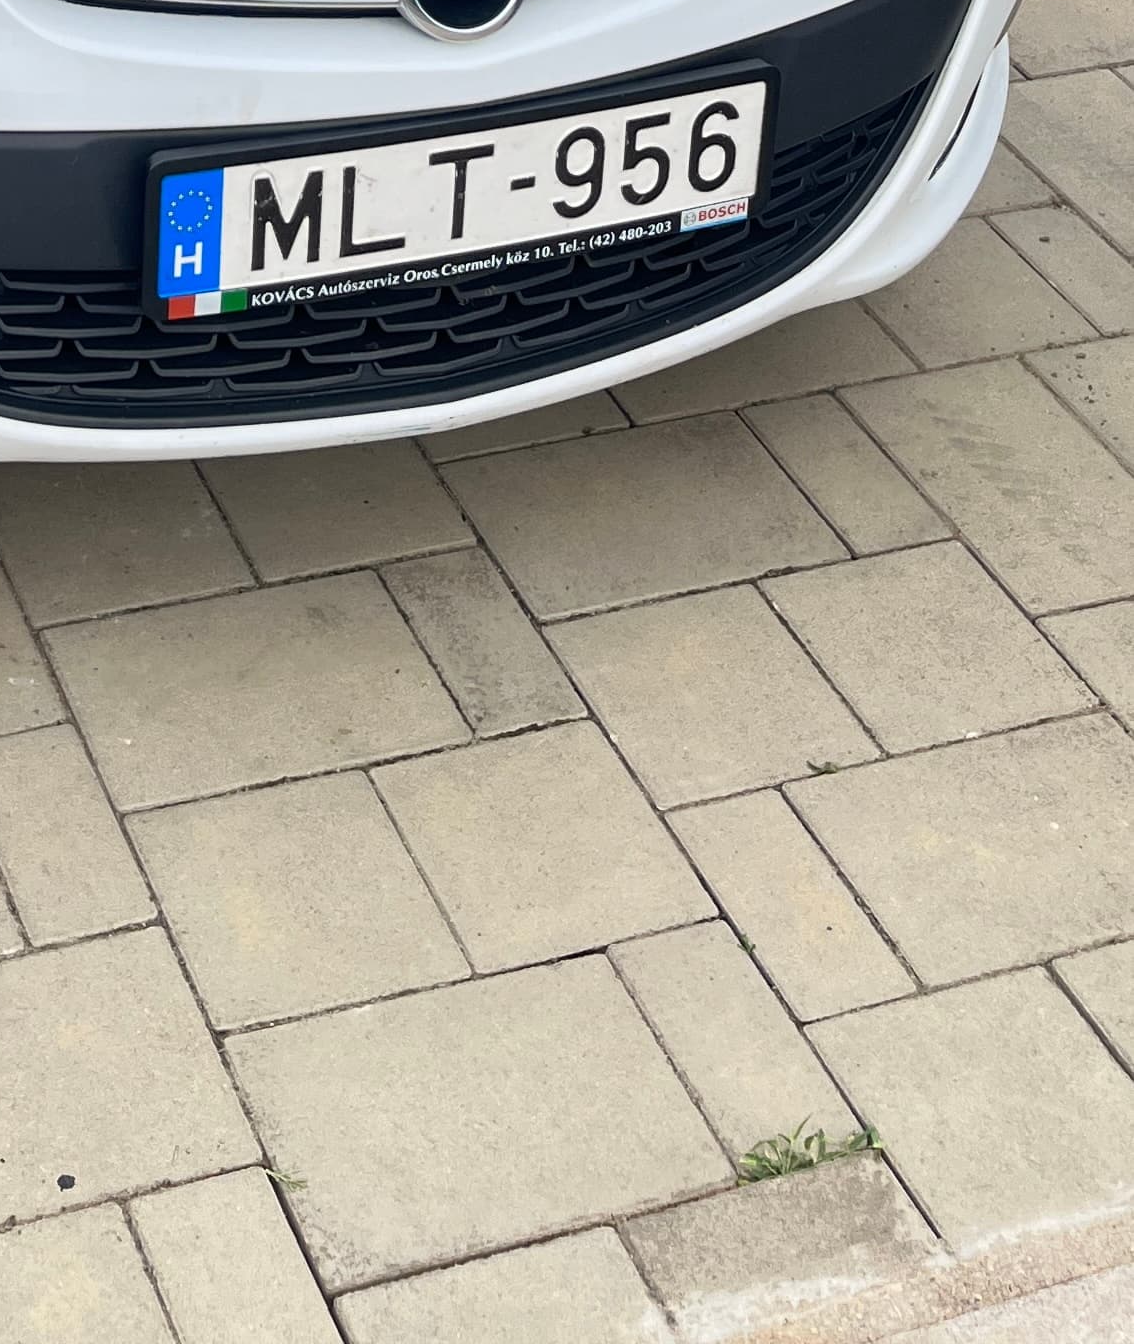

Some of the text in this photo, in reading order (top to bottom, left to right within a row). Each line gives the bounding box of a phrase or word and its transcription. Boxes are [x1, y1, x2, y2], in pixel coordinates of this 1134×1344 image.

[698, 201, 746, 222] BOSCH
[173, 241, 203, 278] H
[251, 285, 315, 307] KOVÁCS
[317, 273, 400, 297] Autószerviz
[441, 255, 504, 277] Csermely
[506, 250, 530, 265] köz
[535, 246, 554, 259] 10.
[558, 240, 586, 255] Tel.:
[588, 231, 616, 251] (42)
[618, 220, 672, 242] 480-203
